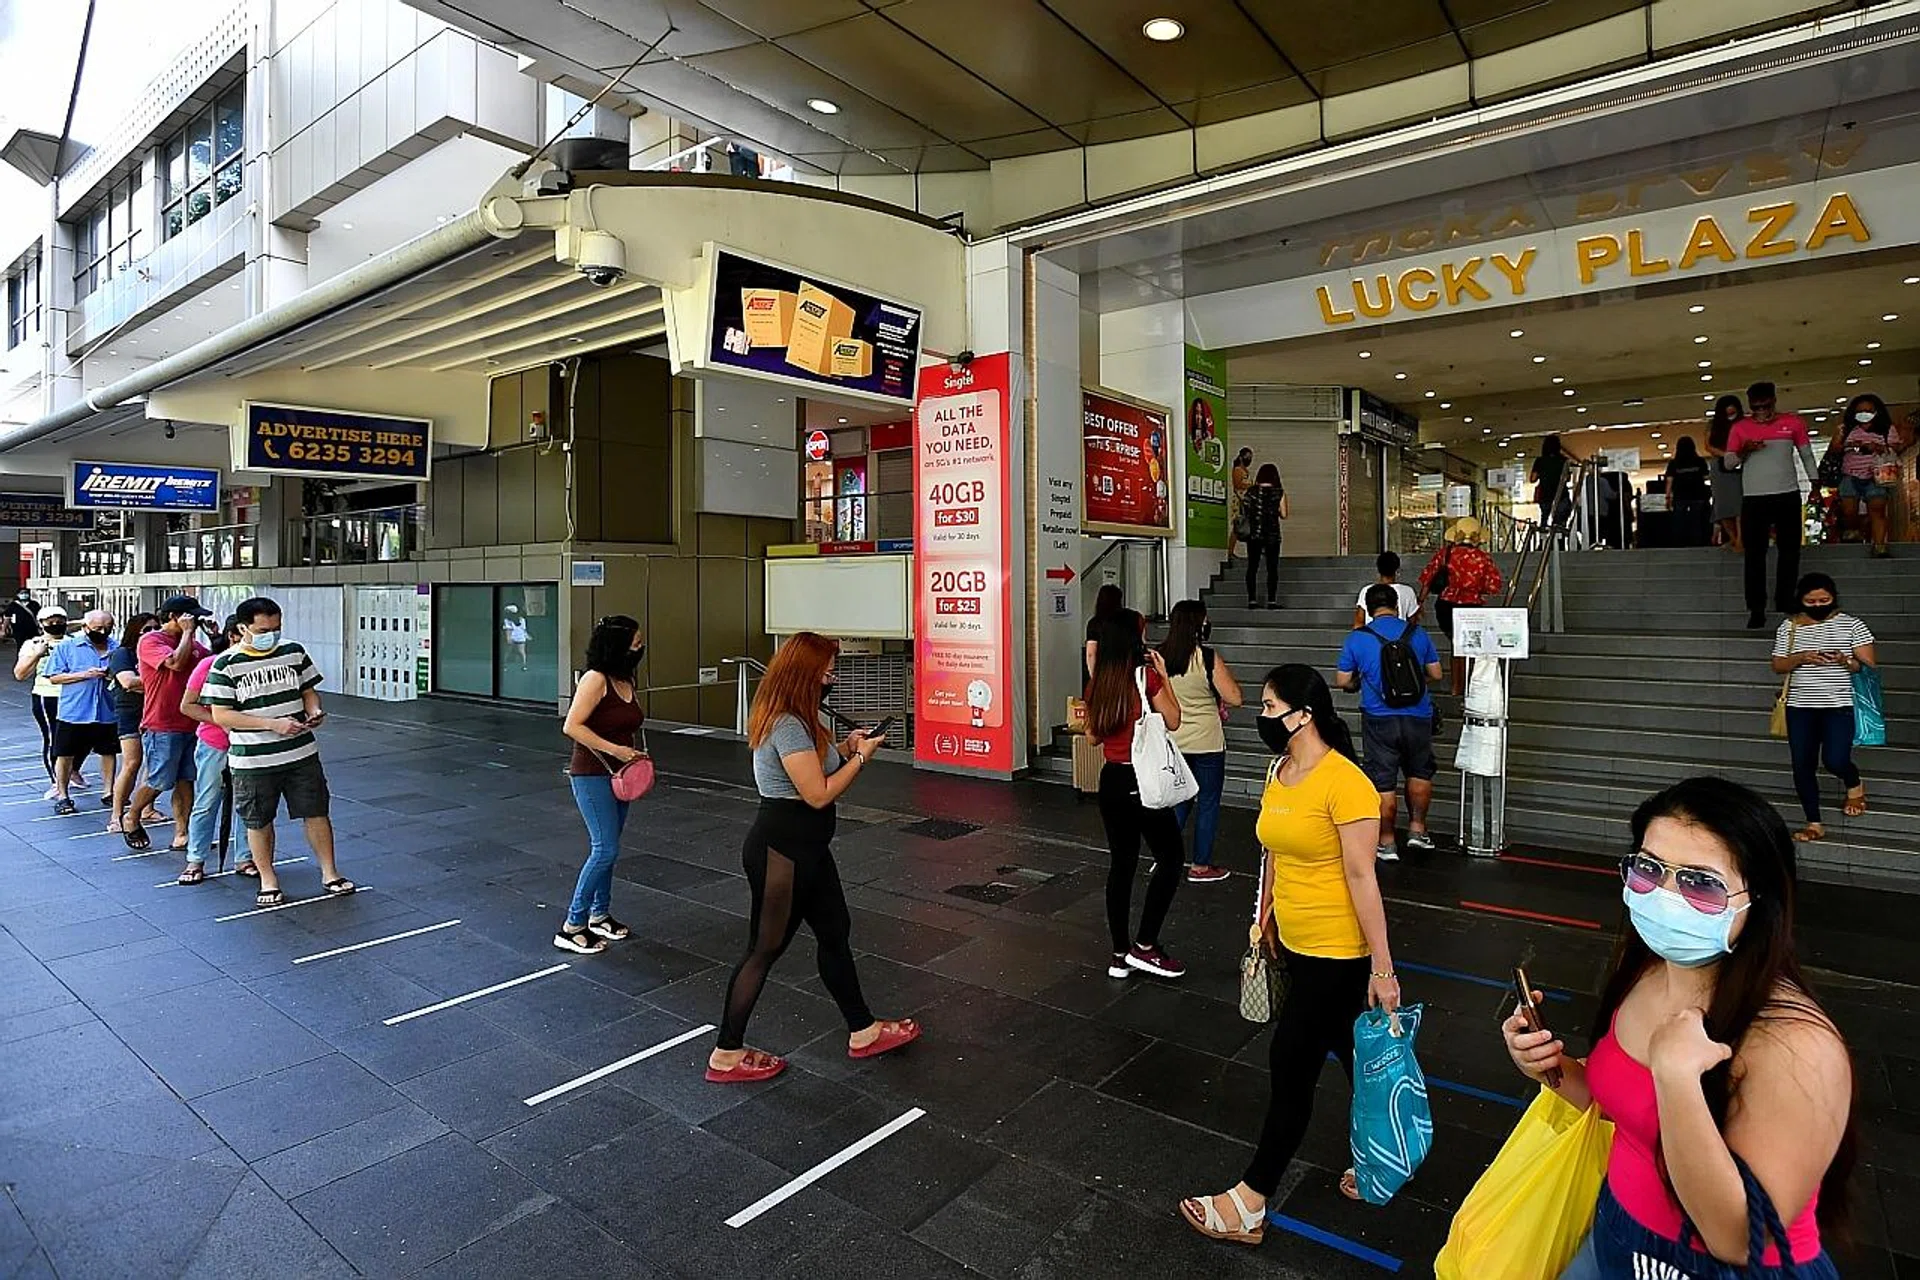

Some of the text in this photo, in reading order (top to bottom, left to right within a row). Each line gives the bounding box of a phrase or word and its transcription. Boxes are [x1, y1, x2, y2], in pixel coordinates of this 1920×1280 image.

[1316, 191, 1873, 325] LUCKY PLAZA
[944, 374, 974, 390] Singtel
[934, 405, 983, 424] ALL THE
[1084, 411, 1104, 430] BEST
[1107, 418, 1139, 438] OFFERS
[257, 421, 423, 447] ADVERTISE HERE
[941, 422, 976, 438] DATA
[289, 441, 415, 467] 6235 3294
[925, 441, 951, 456] YOU
[928, 480, 985, 505] 40GB
[937, 509, 975, 524] for $30
[930, 571, 986, 593] 20GB
[939, 599, 976, 612] for $25
